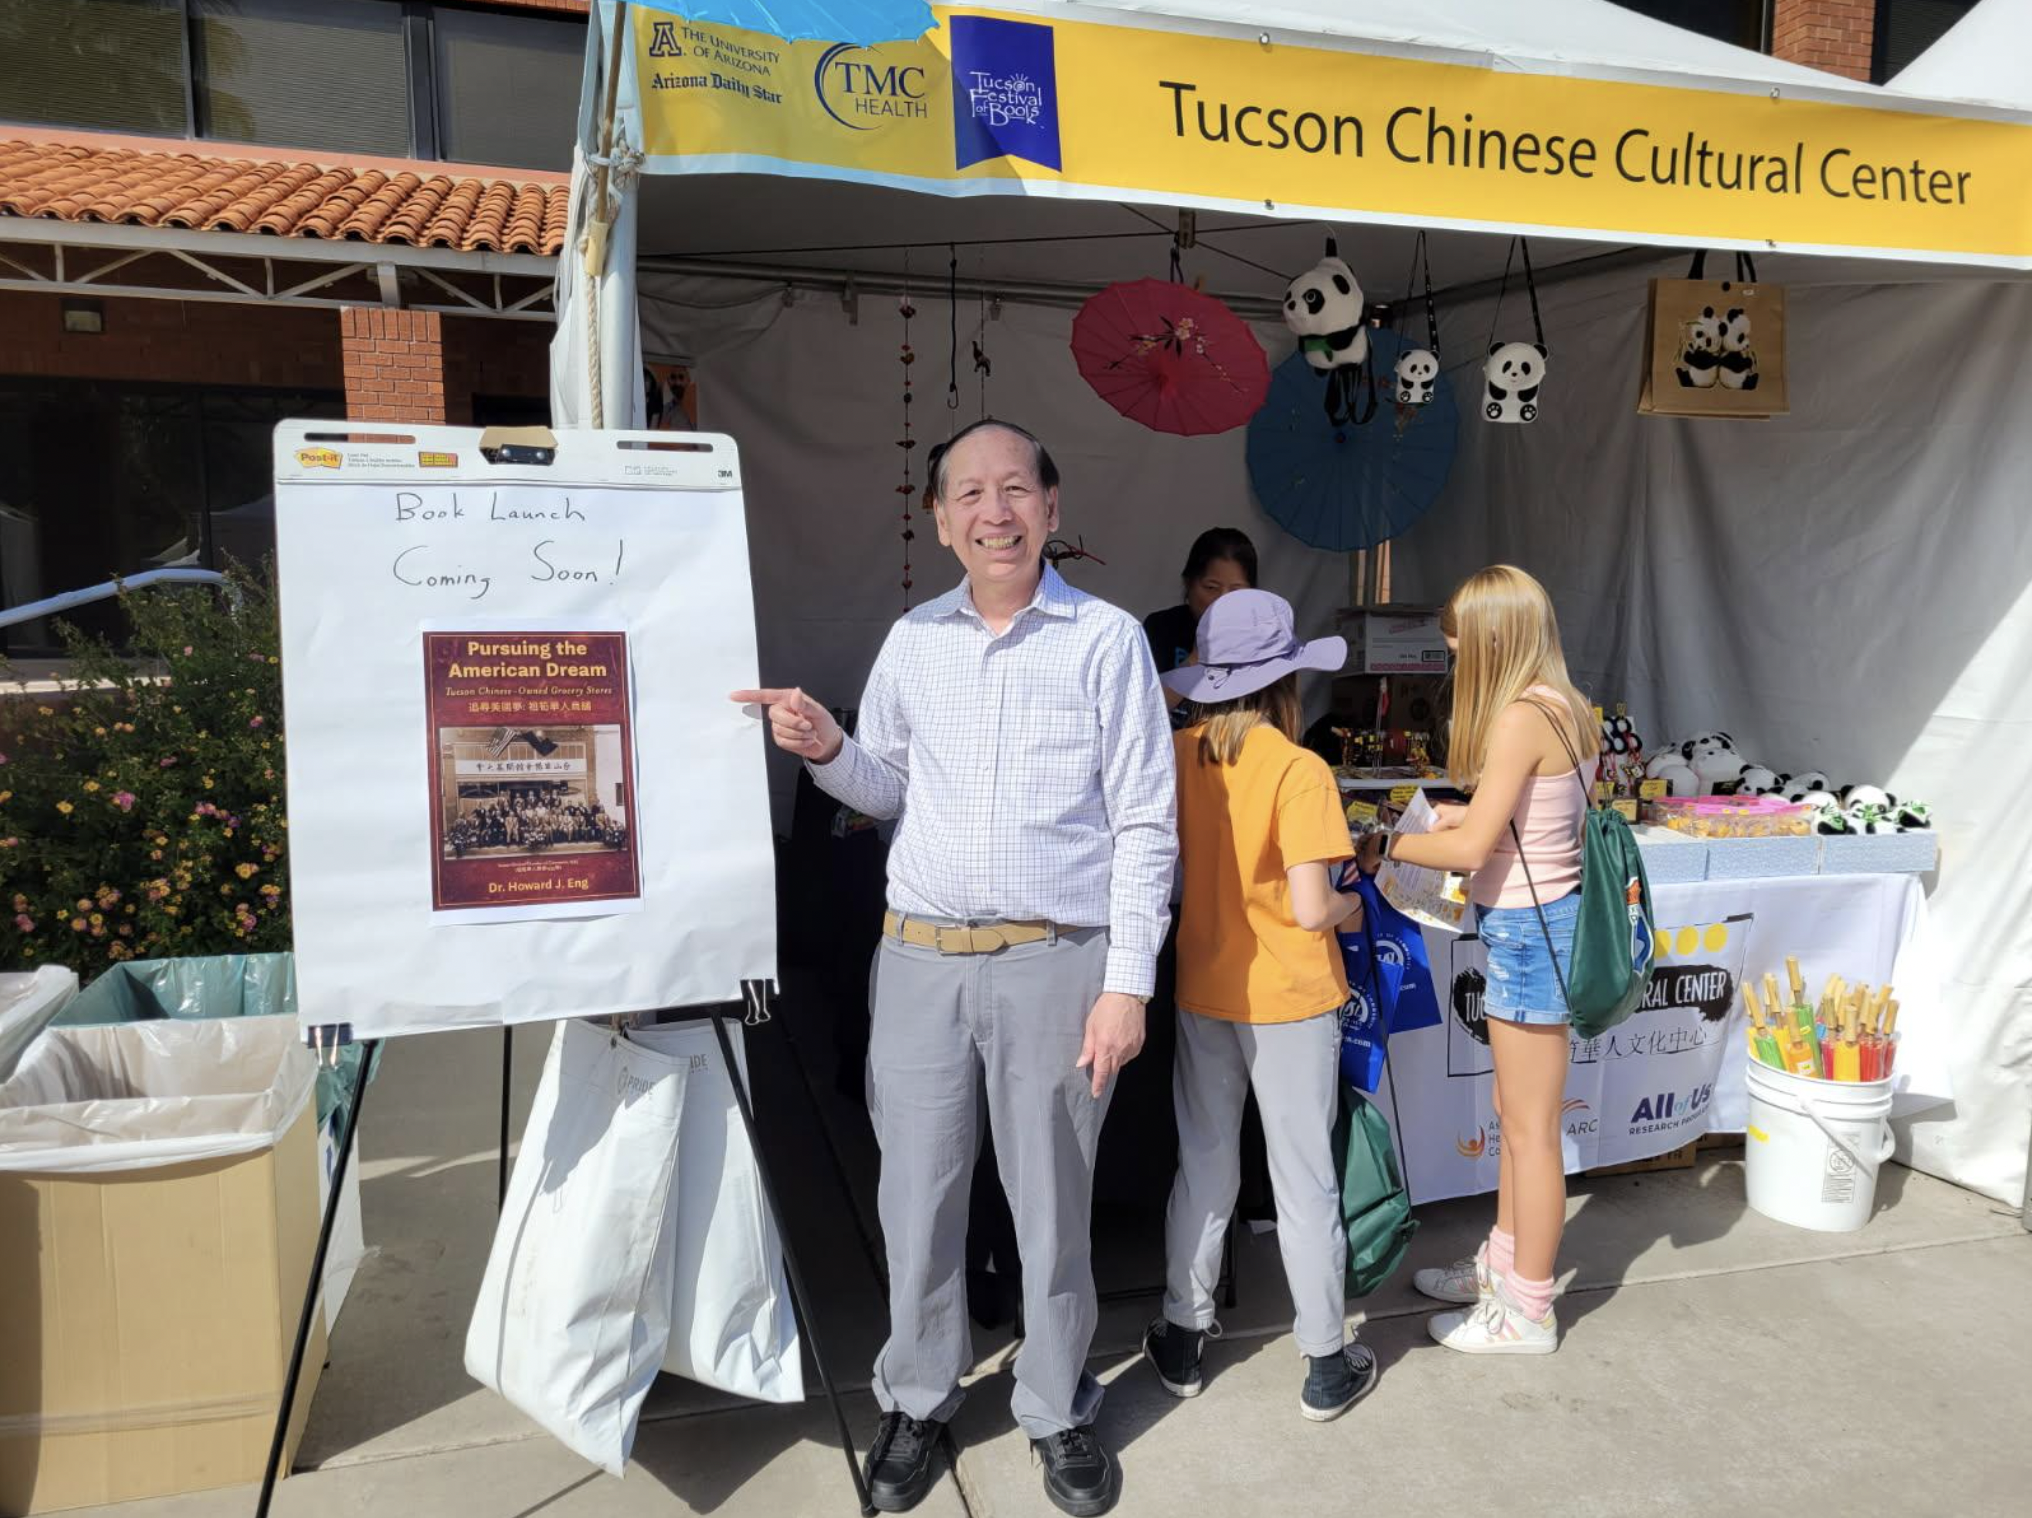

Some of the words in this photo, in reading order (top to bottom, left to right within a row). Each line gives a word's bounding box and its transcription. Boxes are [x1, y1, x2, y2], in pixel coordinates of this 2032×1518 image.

[681, 26, 708, 42] THE
[710, 35, 780, 63] UNIVERSITY
[694, 45, 709, 58] OF
[714, 49, 771, 76] ARIZONA
[651, 71, 708, 90] Arizona
[710, 72, 750, 98] Daily
[752, 84, 782, 104] Star
[834, 61, 926, 99] TMC
[969, 71, 1036, 93] Tucson
[854, 97, 928, 119] HEALTH
[970, 87, 1042, 117] Festival
[975, 100, 989, 113] of
[1159, 79, 1364, 158] Tucson
[1385, 105, 1598, 180] Chinese
[1615, 128, 1804, 194] Cultural
[1820, 147, 1972, 205] Center
[301, 452, 337, 462] Post-it
[718, 470, 733, 478] 3M
[395, 492, 465, 522] Book
[490, 492, 586, 522] Launch
[393, 545, 489, 599] Coming
[468, 641, 551, 659] Pursuing
[556, 641, 588, 656] the
[448, 662, 540, 678] American
[546, 662, 607, 678] Dream
[445, 687, 476, 697] Tucson
[478, 686, 549, 697] Chinese-Owned
[551, 686, 583, 698] Grocery
[586, 686, 613, 696] Stores
[489, 882, 505, 893] Dr.
[508, 879, 552, 892] Howard
[555, 878, 565, 889] J.
[567, 878, 589, 890] Eng
[1675, 971, 1728, 1004] CENTER
[690, 1053, 709, 1069] IDE
[1631, 1092, 1675, 1123] All
[1566, 1119, 1598, 1136] ARC
[1629, 1119, 1680, 1135] RESEARCH
